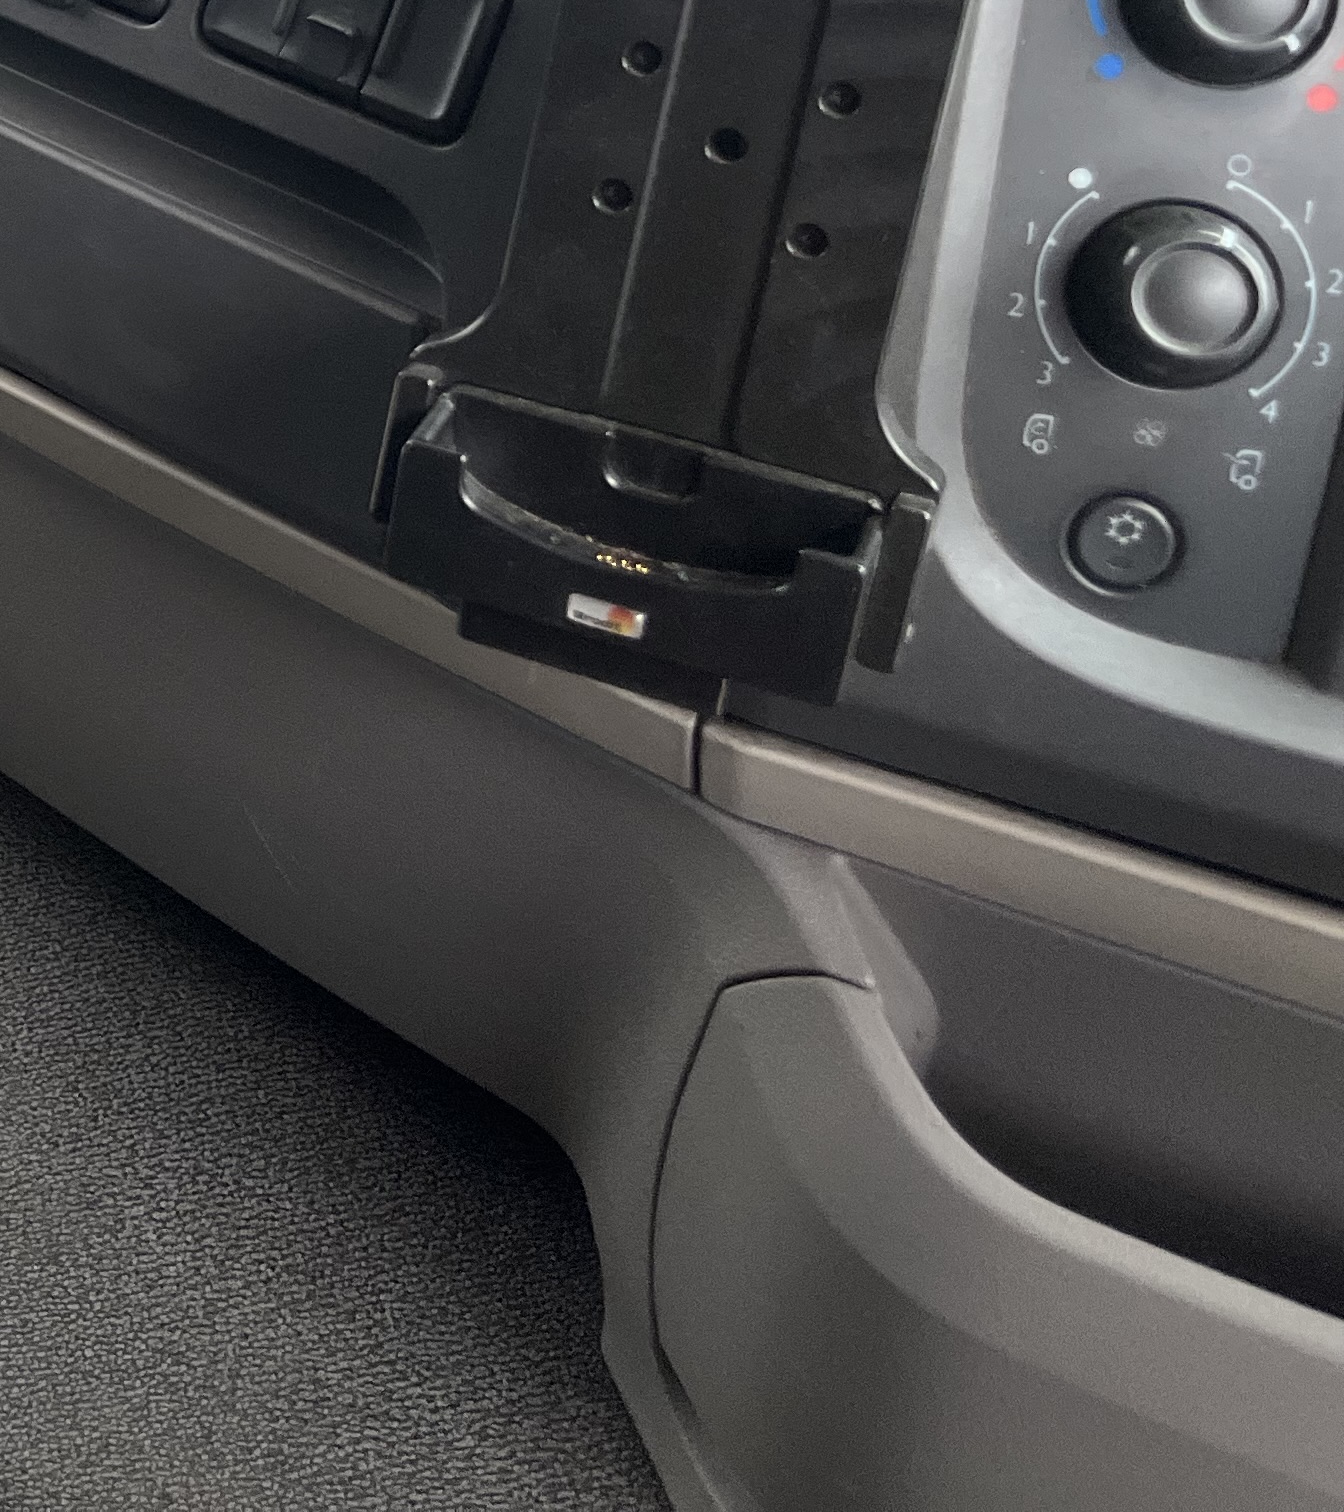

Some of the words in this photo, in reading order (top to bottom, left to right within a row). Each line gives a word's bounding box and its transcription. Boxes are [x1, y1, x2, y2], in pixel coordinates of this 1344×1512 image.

[1303, 199, 1315, 225] 1
[1025, 221, 1035, 245] 1
[1325, 268, 1344, 295] 2
[1007, 292, 1025, 318] 2
[1312, 341, 1330, 367] 3
[1036, 360, 1054, 385] 3
[1259, 399, 1280, 424] 4
